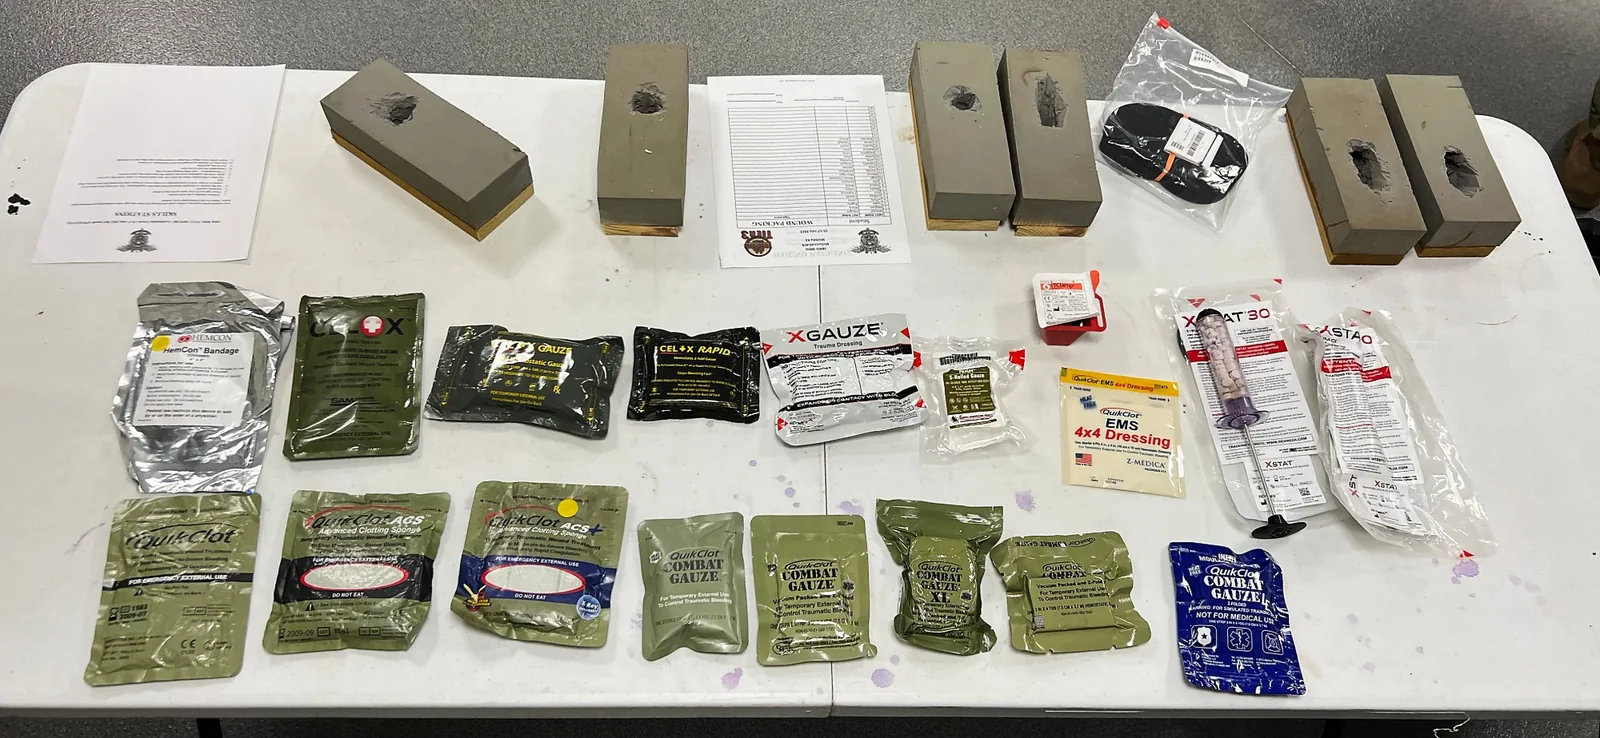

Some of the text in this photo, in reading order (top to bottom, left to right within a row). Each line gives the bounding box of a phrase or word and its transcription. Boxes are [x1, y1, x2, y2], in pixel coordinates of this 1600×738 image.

[1182, 312, 1244, 327] XAT
[537, 344, 573, 354] GAUZE
[697, 346, 731, 356] RAPID
[1127, 384, 1154, 392] Dressing
[1102, 409, 1139, 418] QuikClot
[1106, 418, 1139, 431] EMS
[1074, 427, 1170, 449] 4x4 Dressing
[1126, 458, 1166, 468] Z-MEDICA
[312, 514, 390, 529] QuikClot
[531, 526, 560, 536] Clotting
[561, 530, 588, 539] Sponge
[134, 529, 236, 550] QuikClot
[571, 539, 601, 550] Treatment
[670, 550, 720, 560] QuikClot
[663, 559, 724, 572] COMBAT
[788, 561, 834, 570] QuikClot
[921, 564, 959, 573] QuikClot
[670, 571, 719, 584] GAUZE
[782, 568, 838, 580] COMBAT
[916, 571, 962, 582] COMBAT
[1210, 566, 1260, 579] QuikClo
[788, 580, 834, 591] GAUZE
[921, 581, 958, 591] GAUZE
[1203, 575, 1264, 590] COMBAT
[930, 592, 950, 603] XL
[1211, 588, 1261, 602] GAUZE
[1230, 614, 1263, 622] MEDICAL
